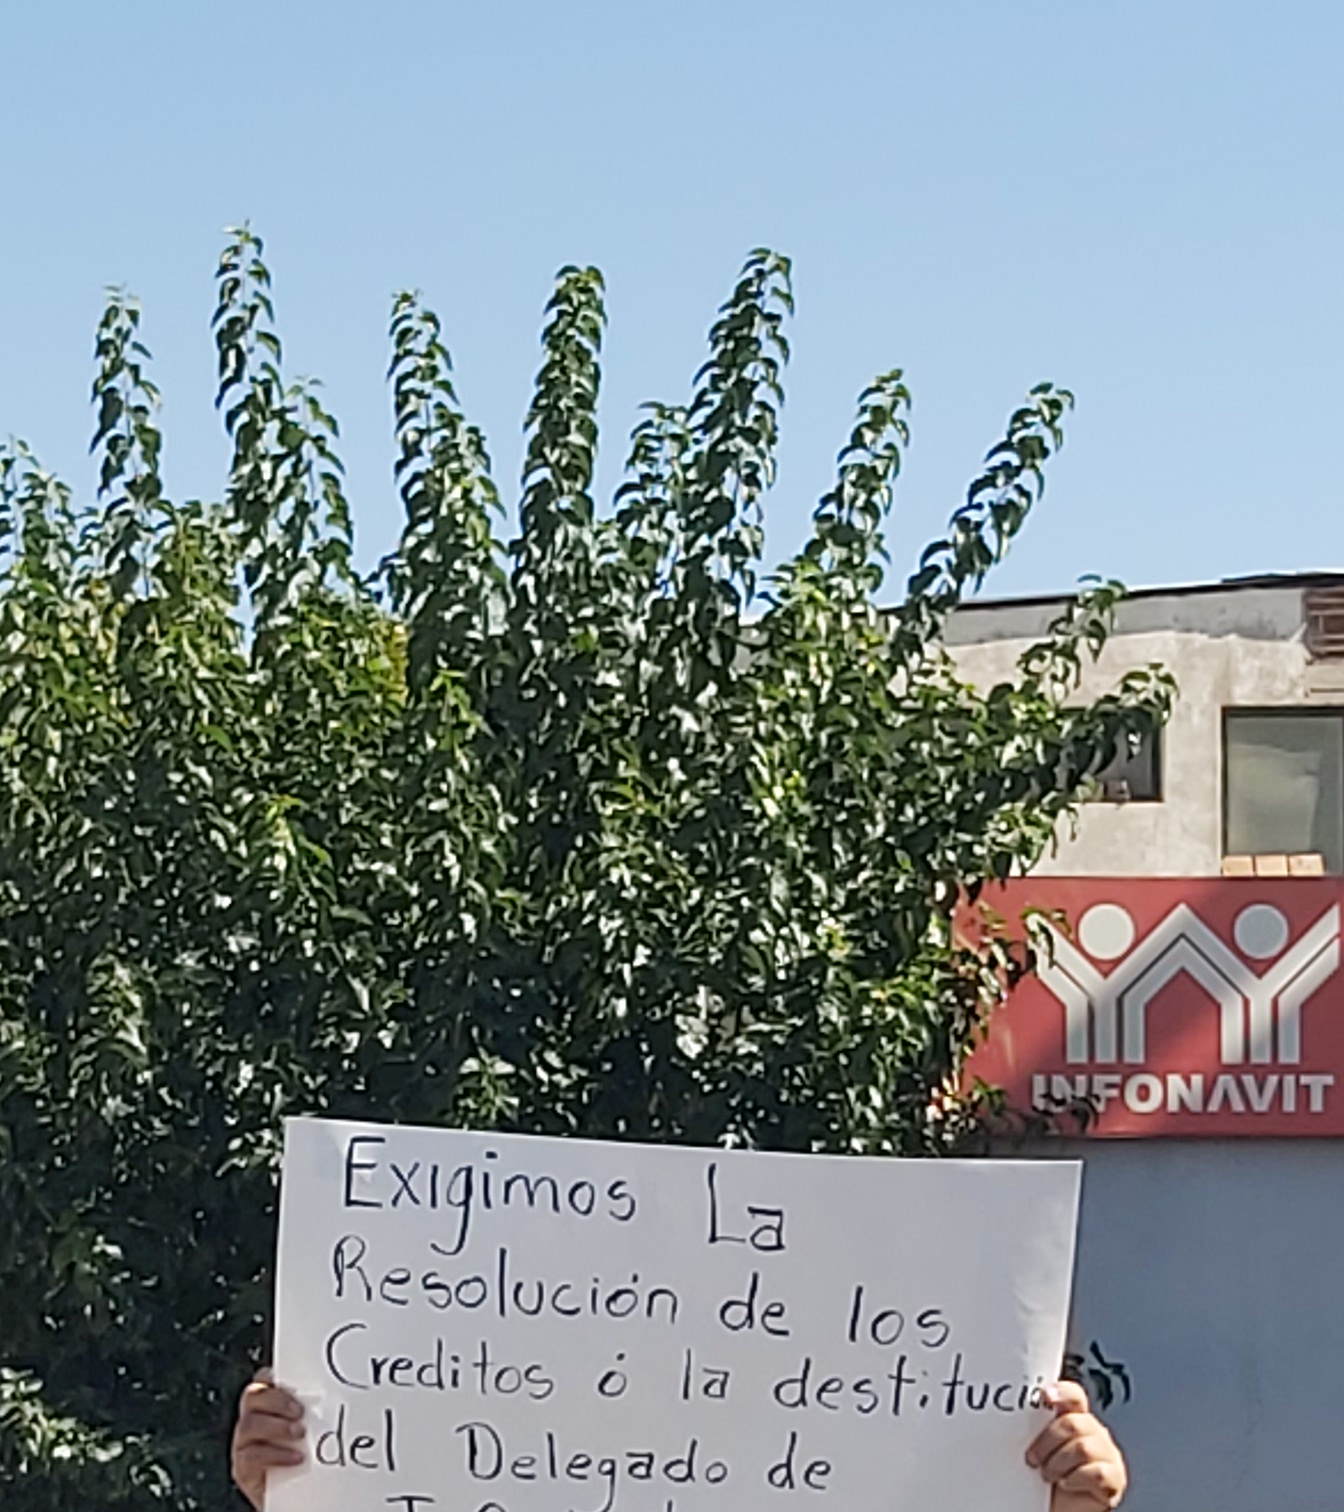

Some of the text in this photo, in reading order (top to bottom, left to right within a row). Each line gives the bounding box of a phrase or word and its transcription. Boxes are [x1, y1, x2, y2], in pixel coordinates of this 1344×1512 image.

[1031, 1073, 1335, 1114] INFONAVIT
[341, 1134, 786, 1257] Exigimos La
[332, 1233, 951, 1349] Resolución de los
[325, 1322, 555, 1401] Creditos
[682, 1347, 731, 1401] la
[310, 1403, 396, 1473] del
[766, 1430, 832, 1491] de
